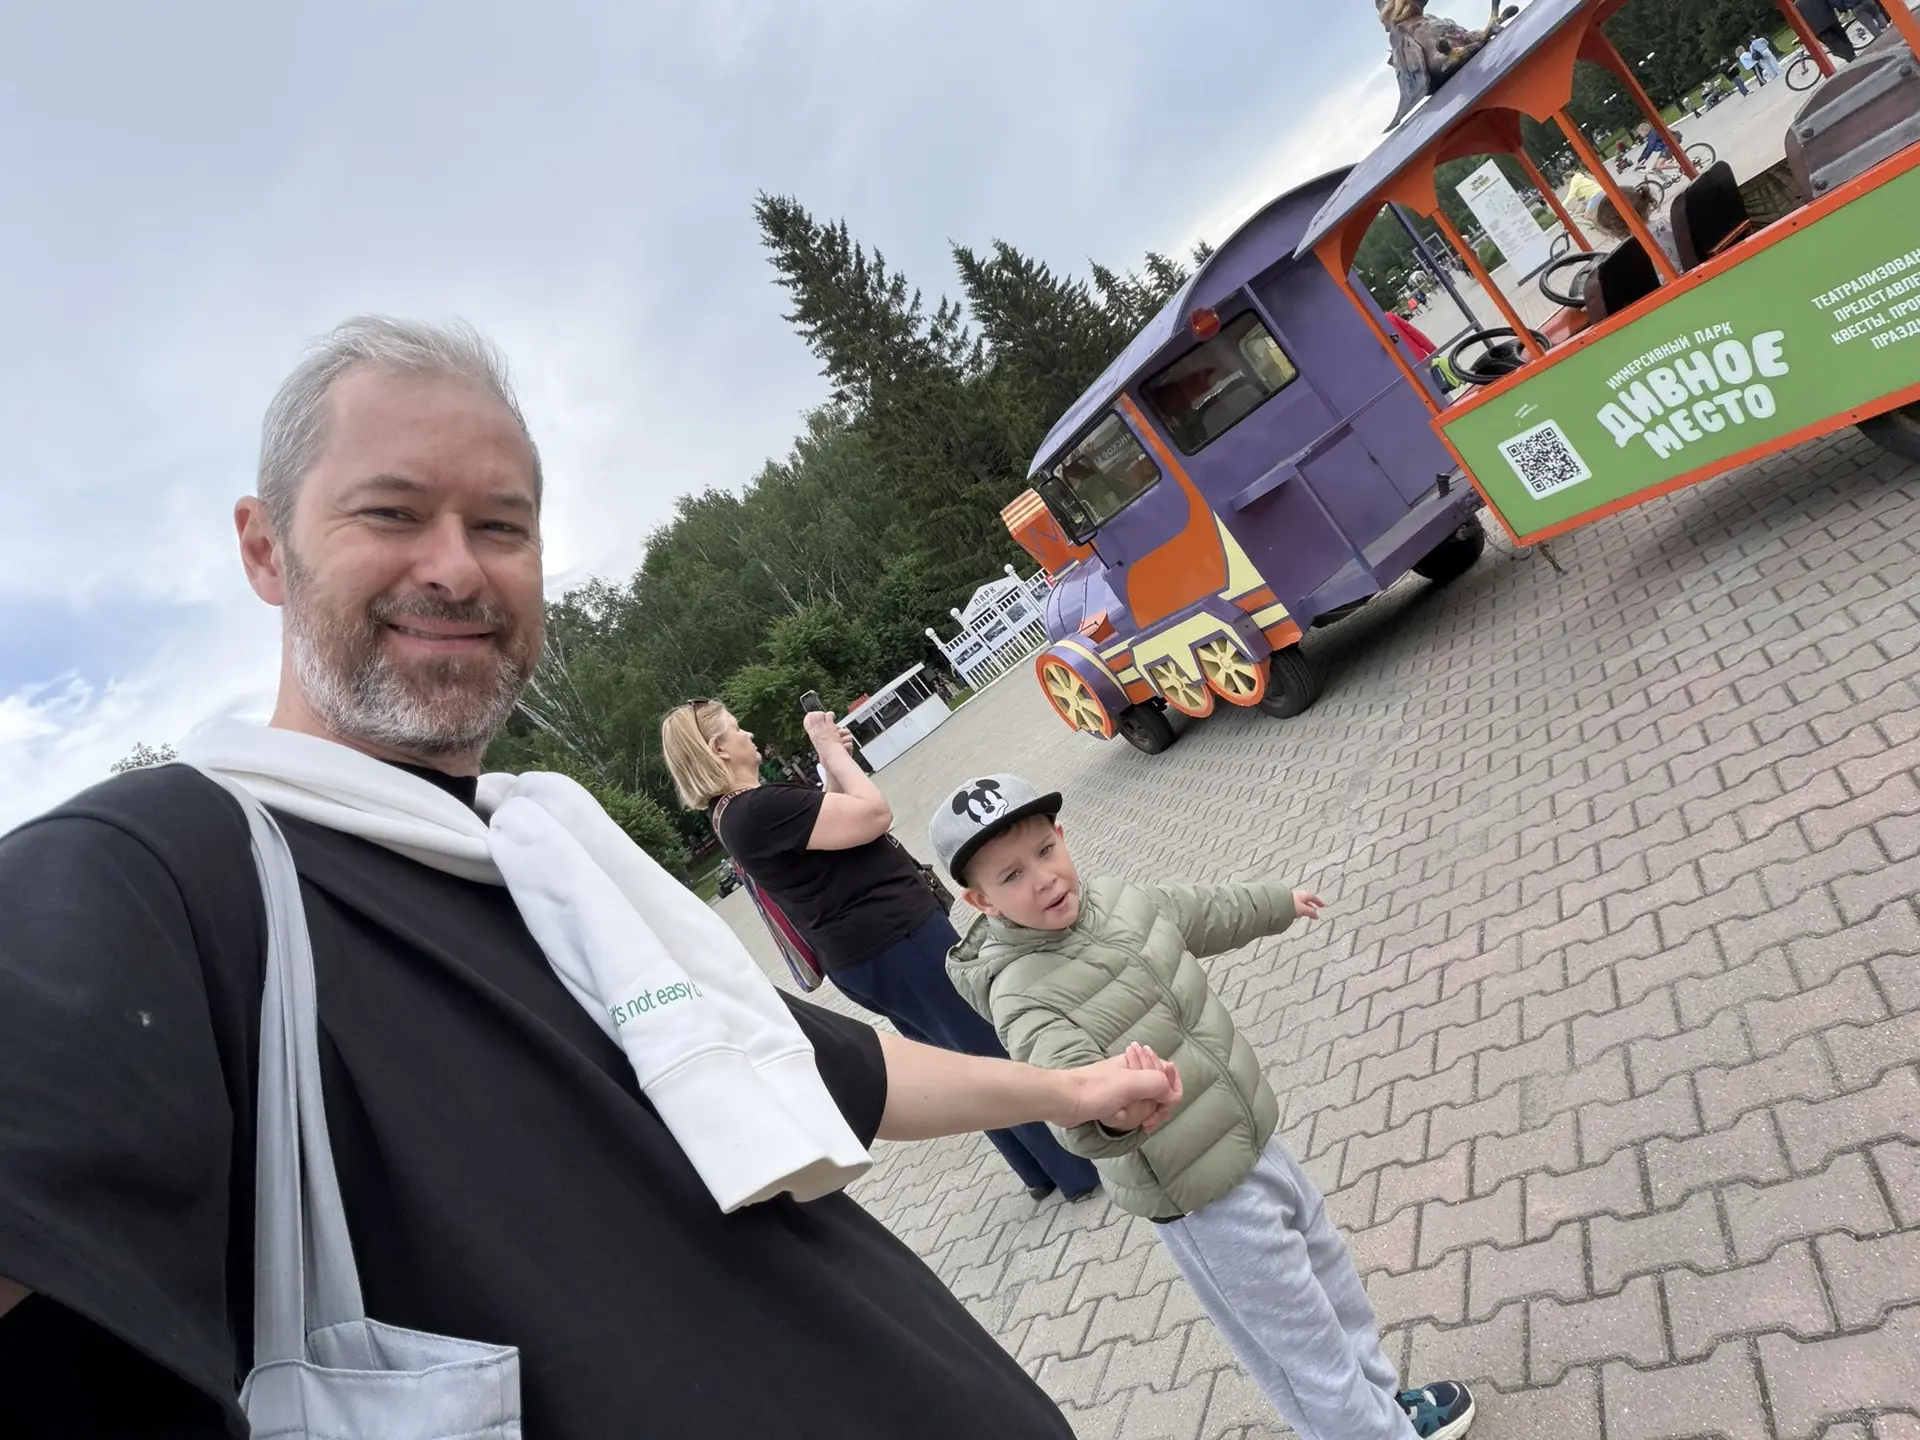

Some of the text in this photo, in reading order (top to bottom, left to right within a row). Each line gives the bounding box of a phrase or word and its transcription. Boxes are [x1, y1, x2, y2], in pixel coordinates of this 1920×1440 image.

[1833, 271, 1920, 322] ПРЕДСТАВЛЕ
[1605, 321, 1733, 390] ИММЕРСИВНЫЙ ПАРК
[1596, 330, 1789, 448] ДИВНОЕ
[1643, 383, 1776, 459] МЕСТО
[974, 586, 996, 606] ПАРК
[626, 988, 656, 1019] not
[656, 980, 693, 1005] easy
